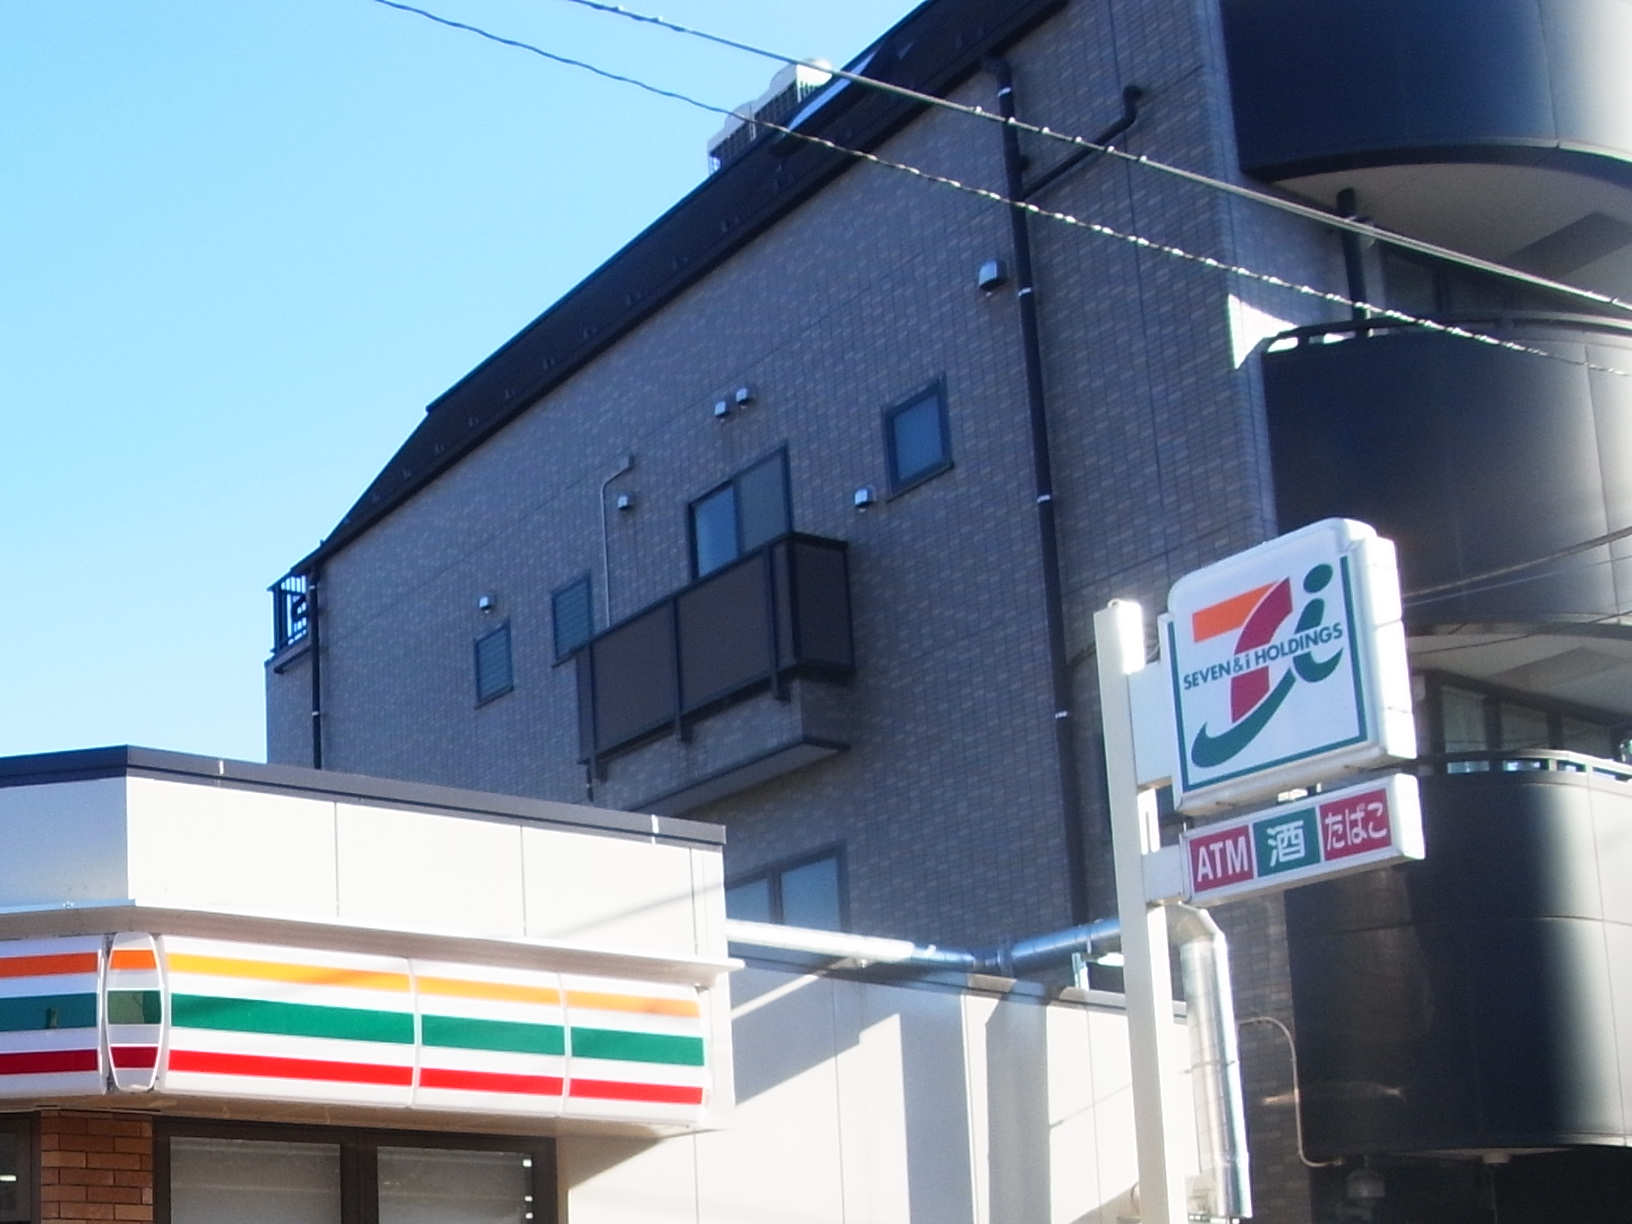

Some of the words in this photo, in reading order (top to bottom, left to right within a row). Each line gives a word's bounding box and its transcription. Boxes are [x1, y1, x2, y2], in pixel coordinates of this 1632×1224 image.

[1254, 622, 1344, 668] HOLDINGS
[1196, 834, 1250, 883] ATM
[1267, 819, 1305, 867] 酒
[1324, 801, 1388, 852] たばこ
